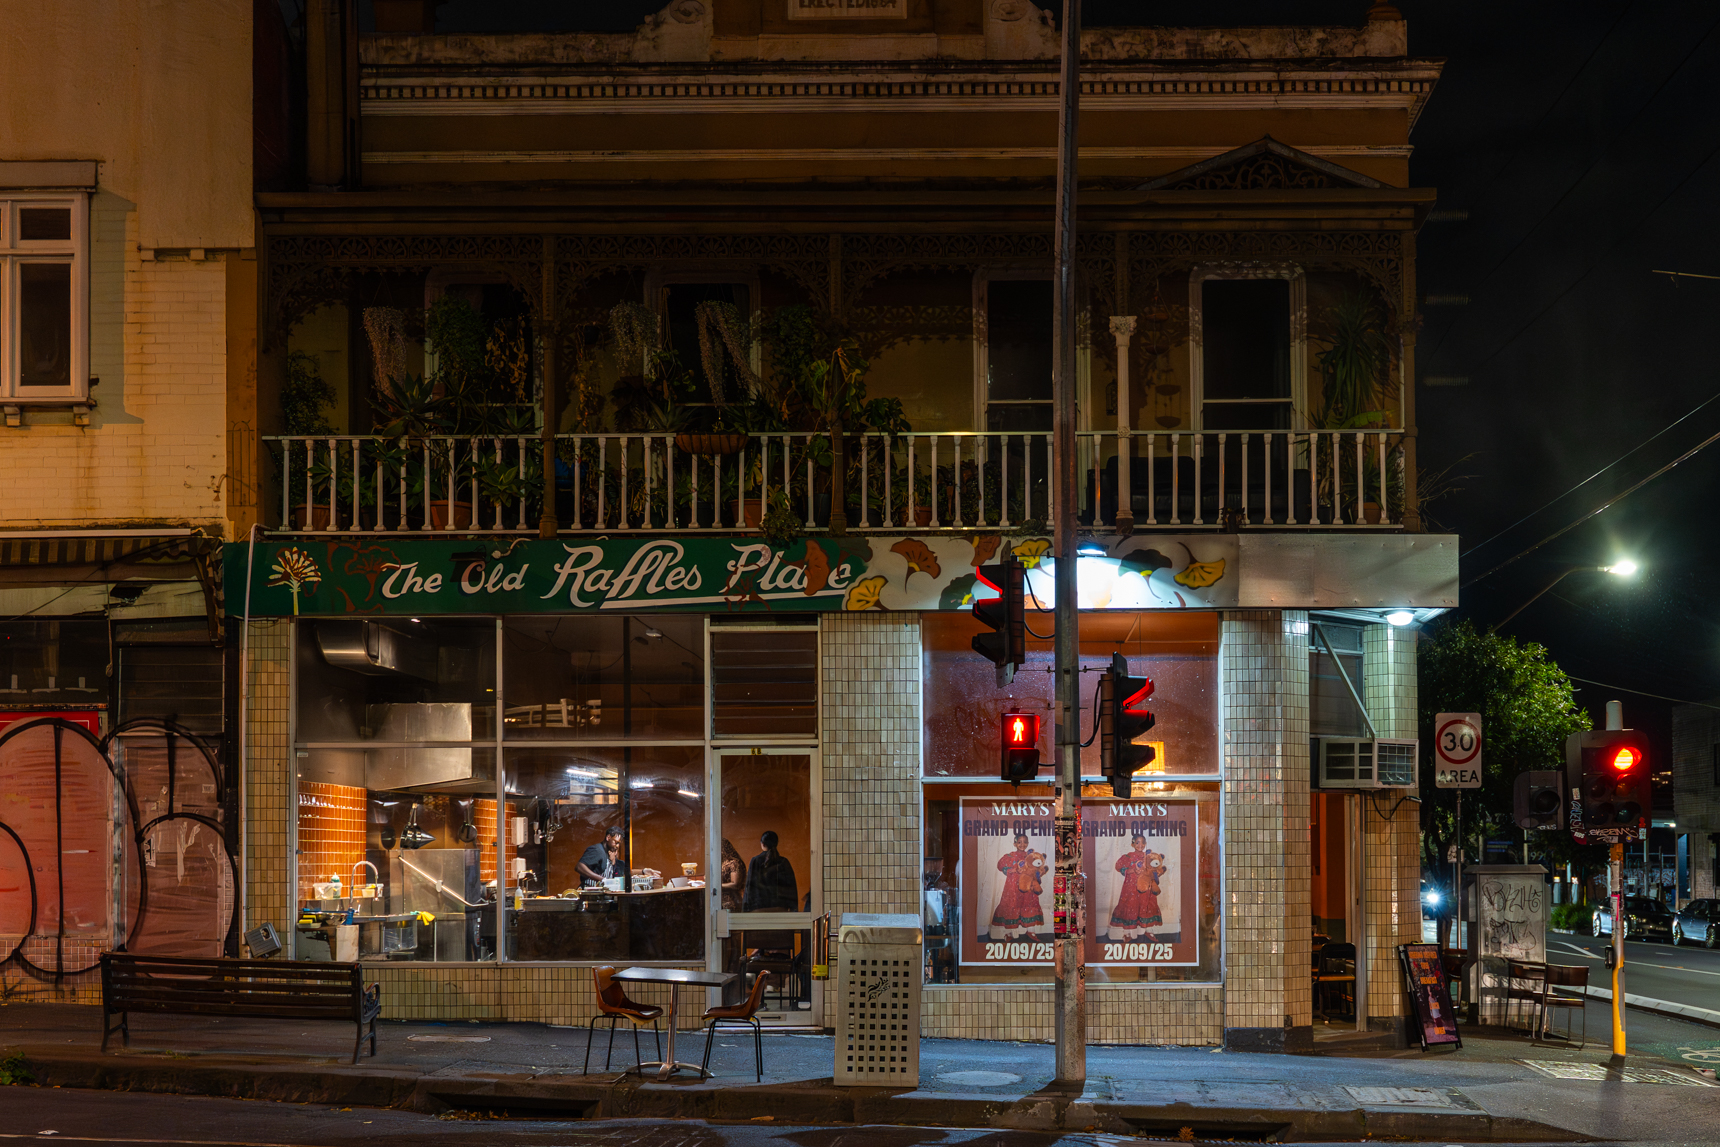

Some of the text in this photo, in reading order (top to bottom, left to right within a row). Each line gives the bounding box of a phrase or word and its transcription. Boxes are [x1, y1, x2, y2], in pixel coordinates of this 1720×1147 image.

[380, 539, 852, 608] The Old Raffles Plae
[1443, 732, 1474, 752] 30
[1438, 769, 1479, 783] AREA
[991, 802, 1050, 816] MARY'S
[1108, 802, 1168, 817] MARY'S
[964, 819, 1056, 837] GRAND OPENI
[1083, 820, 1126, 837] GRAND
[1131, 820, 1187, 837] OPENING
[985, 942, 1055, 960] 20/09/25
[1104, 943, 1174, 961] 20/09/25
